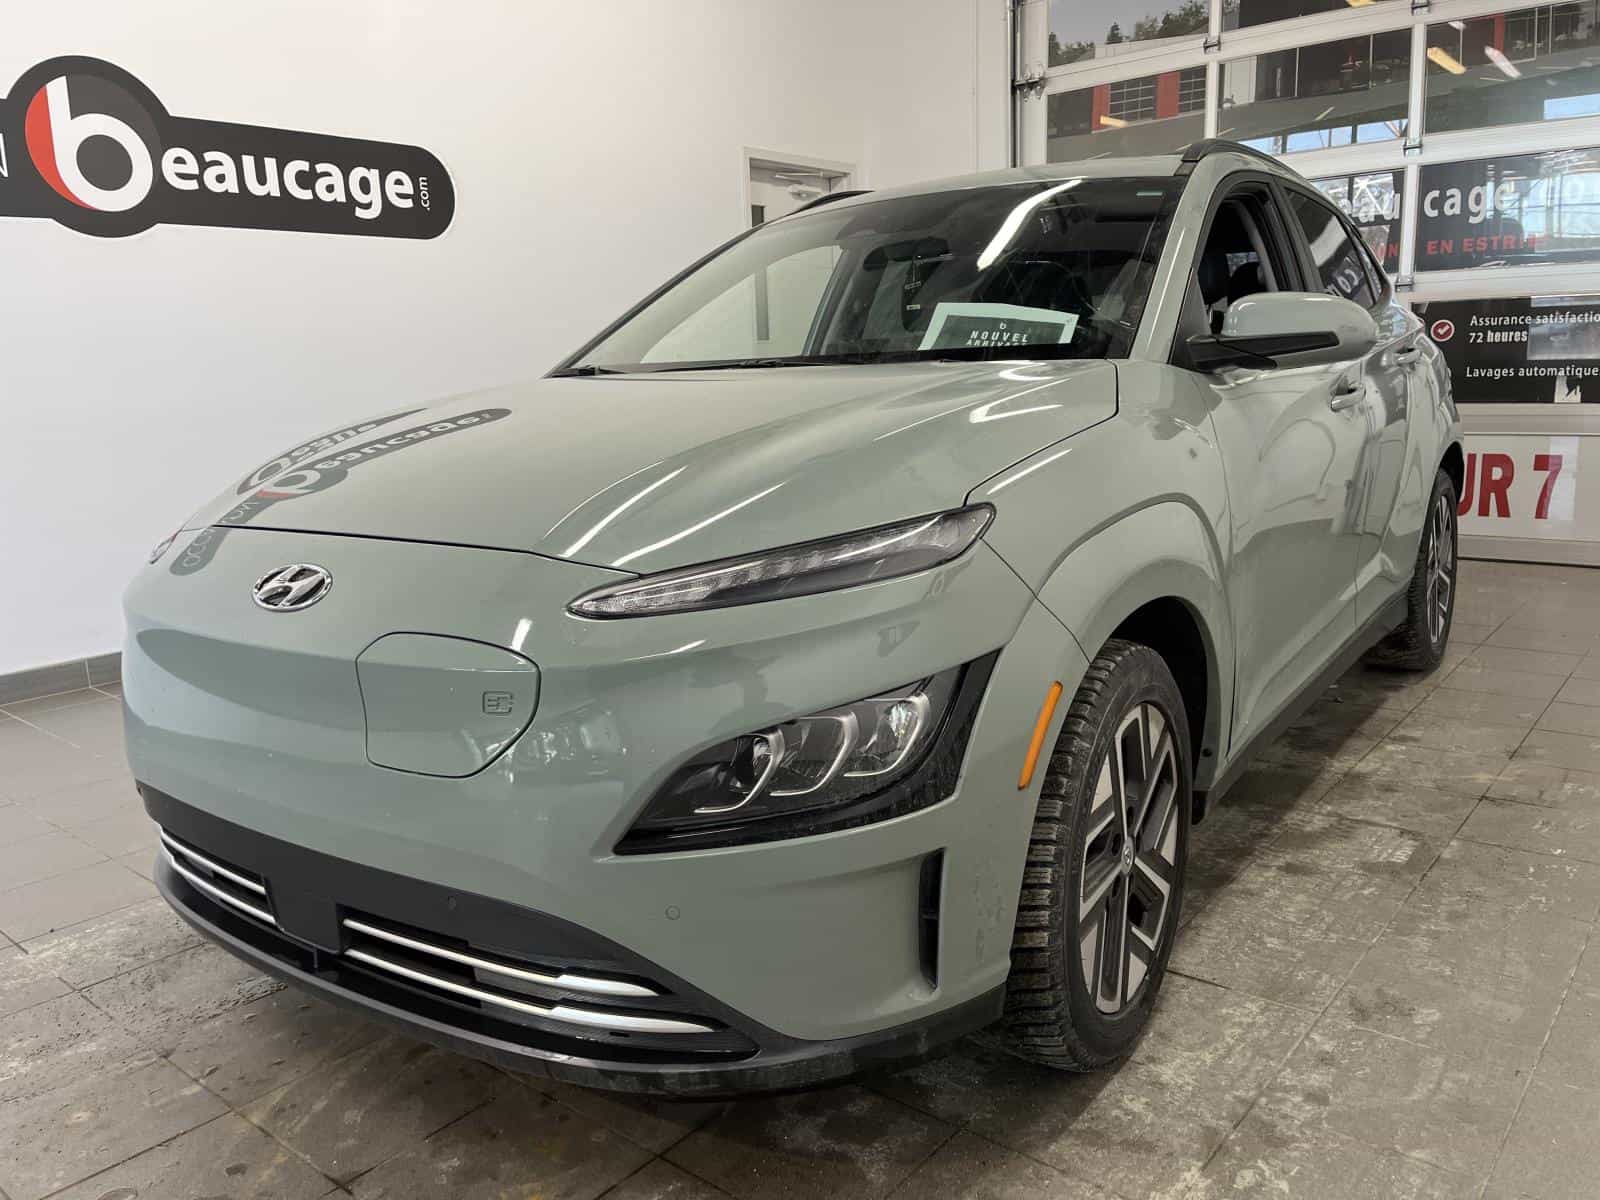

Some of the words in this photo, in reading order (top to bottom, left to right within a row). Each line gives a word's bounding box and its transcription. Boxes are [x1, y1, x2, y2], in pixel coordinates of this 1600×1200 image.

[1426, 240, 1453, 255] EN
[1470, 314, 1532, 327] Assurance
[970, 330, 1029, 343] NOUVEL
[1469, 332, 1484, 343] 72
[1487, 330, 1528, 343] heures
[1466, 366, 1515, 379] Lavages
[1533, 454, 1563, 519] 7
